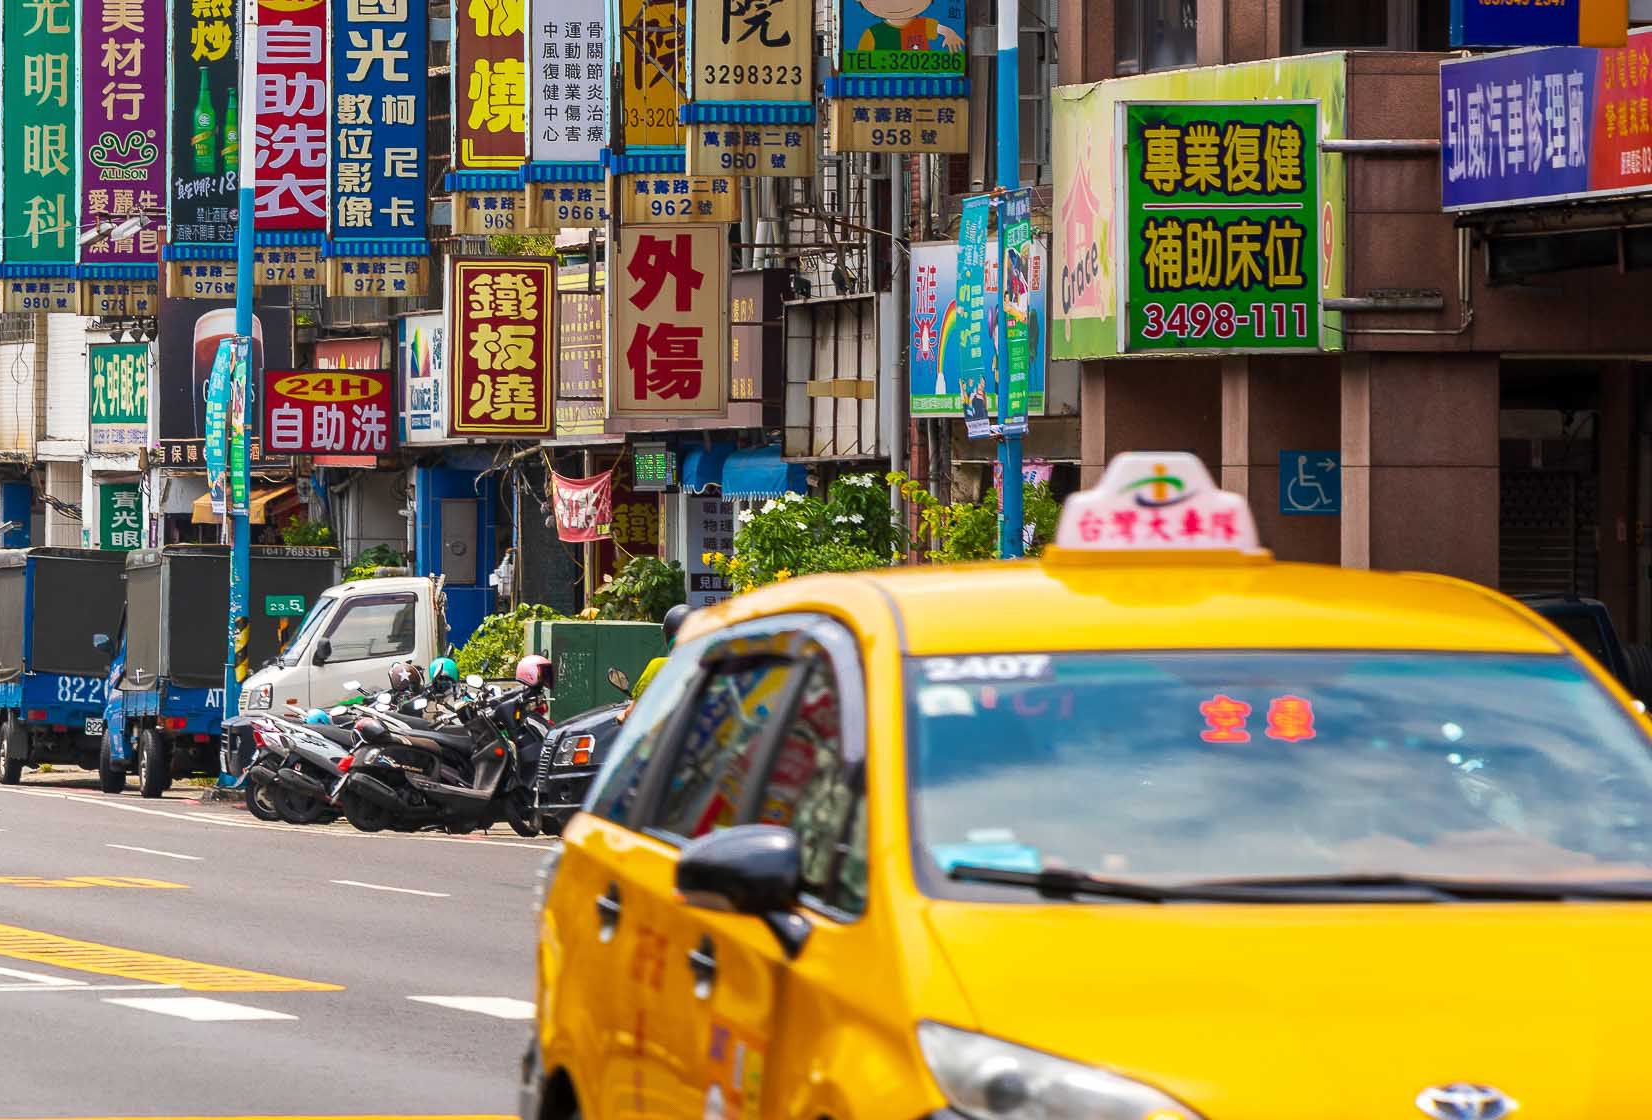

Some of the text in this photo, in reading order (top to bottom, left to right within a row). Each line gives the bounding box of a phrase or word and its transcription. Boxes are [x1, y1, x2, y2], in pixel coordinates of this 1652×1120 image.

[542, 21, 560, 143] 中風復健中心
[564, 21, 581, 143] 運動職業傷害
[587, 21, 604, 143] 骨關節炎治療
[704, 64, 803, 86] 3298323
[255, 19, 327, 218] 自助洗衣
[703, 130, 802, 148] 萬壽路二段
[852, 107, 957, 125] 萬壽路二段
[100, 169, 148, 181] ALLISON
[337, 93, 373, 228] 數位影像
[379, 93, 419, 228] 柯尼卡
[635, 179, 729, 195] 萬壽路二段
[1143, 121, 1304, 194] 專業復健
[341, 261, 419, 275] 萬壽路二段
[1061, 239, 1101, 314] Grace
[1143, 219, 1305, 290] 補助床位
[468, 273, 538, 421] 鐵板燒
[627, 234, 704, 401] 外傷
[1141, 302, 1308, 340] 3498-111
[285, 378, 372, 397] 24H
[271, 402, 387, 452] 自助洗
[111, 491, 140, 548] 青光眼
[1078, 507, 1243, 545] 台灣大車隊
